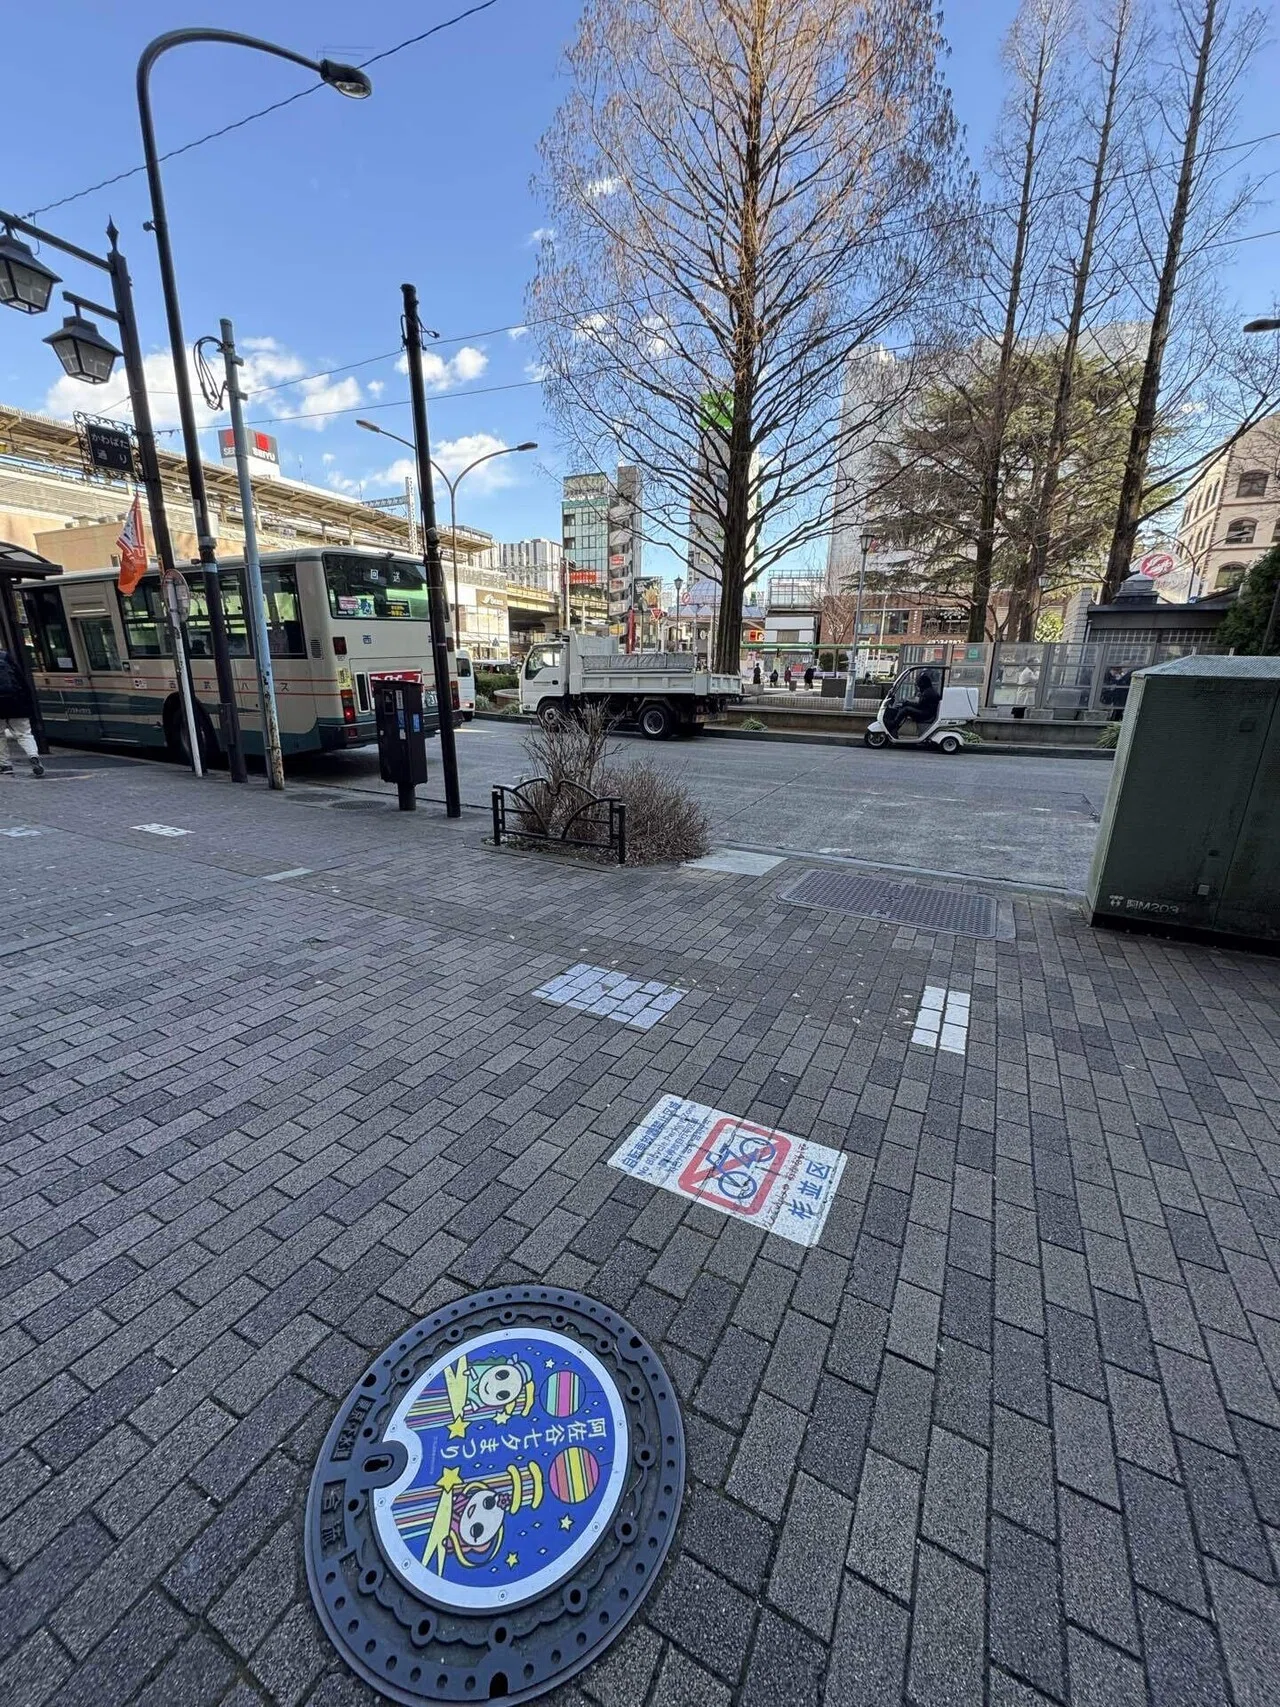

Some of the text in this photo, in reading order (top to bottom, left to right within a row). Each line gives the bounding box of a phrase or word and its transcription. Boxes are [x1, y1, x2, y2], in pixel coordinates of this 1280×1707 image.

[91, 433, 129, 449] かわばた
[252, 447, 276, 462] SEIYU
[371, 569, 400, 582] 回送
[636, 1165, 650, 1176] No
[786, 1159, 832, 1221] 杉並区
[441, 1417, 607, 1459] 阿佐谷七夕まつり
[321, 1487, 343, 1547] 合流
